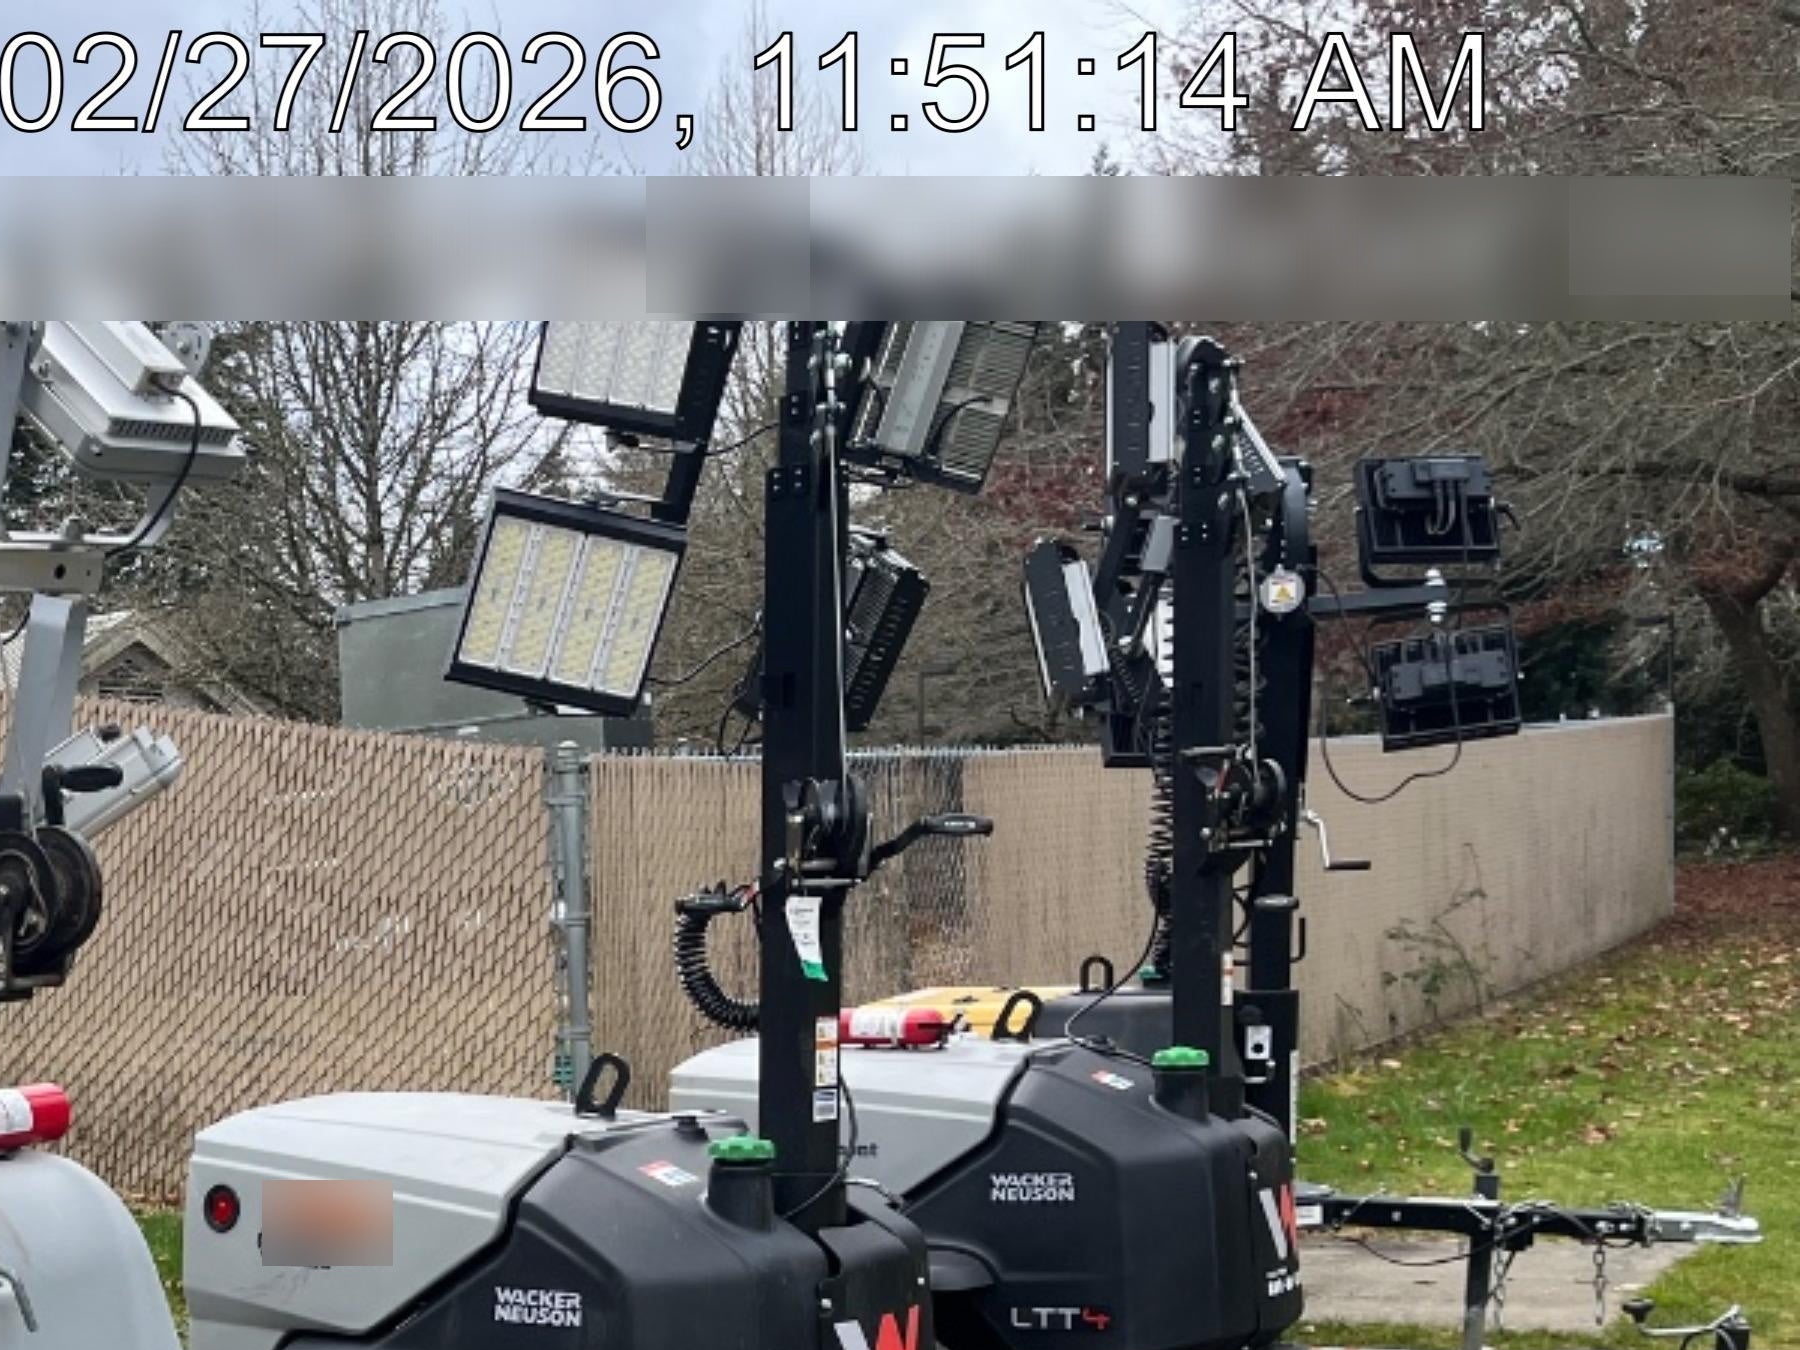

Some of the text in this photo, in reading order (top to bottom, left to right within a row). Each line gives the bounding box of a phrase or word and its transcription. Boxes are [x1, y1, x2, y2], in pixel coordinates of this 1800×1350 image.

[990, 1172, 1073, 1187] WACKER
[991, 1187, 1075, 1201] NEUSON
[494, 1286, 583, 1309] WACKER
[494, 1304, 582, 1327] NEUSON
[1011, 1306, 1111, 1330] LTT4
